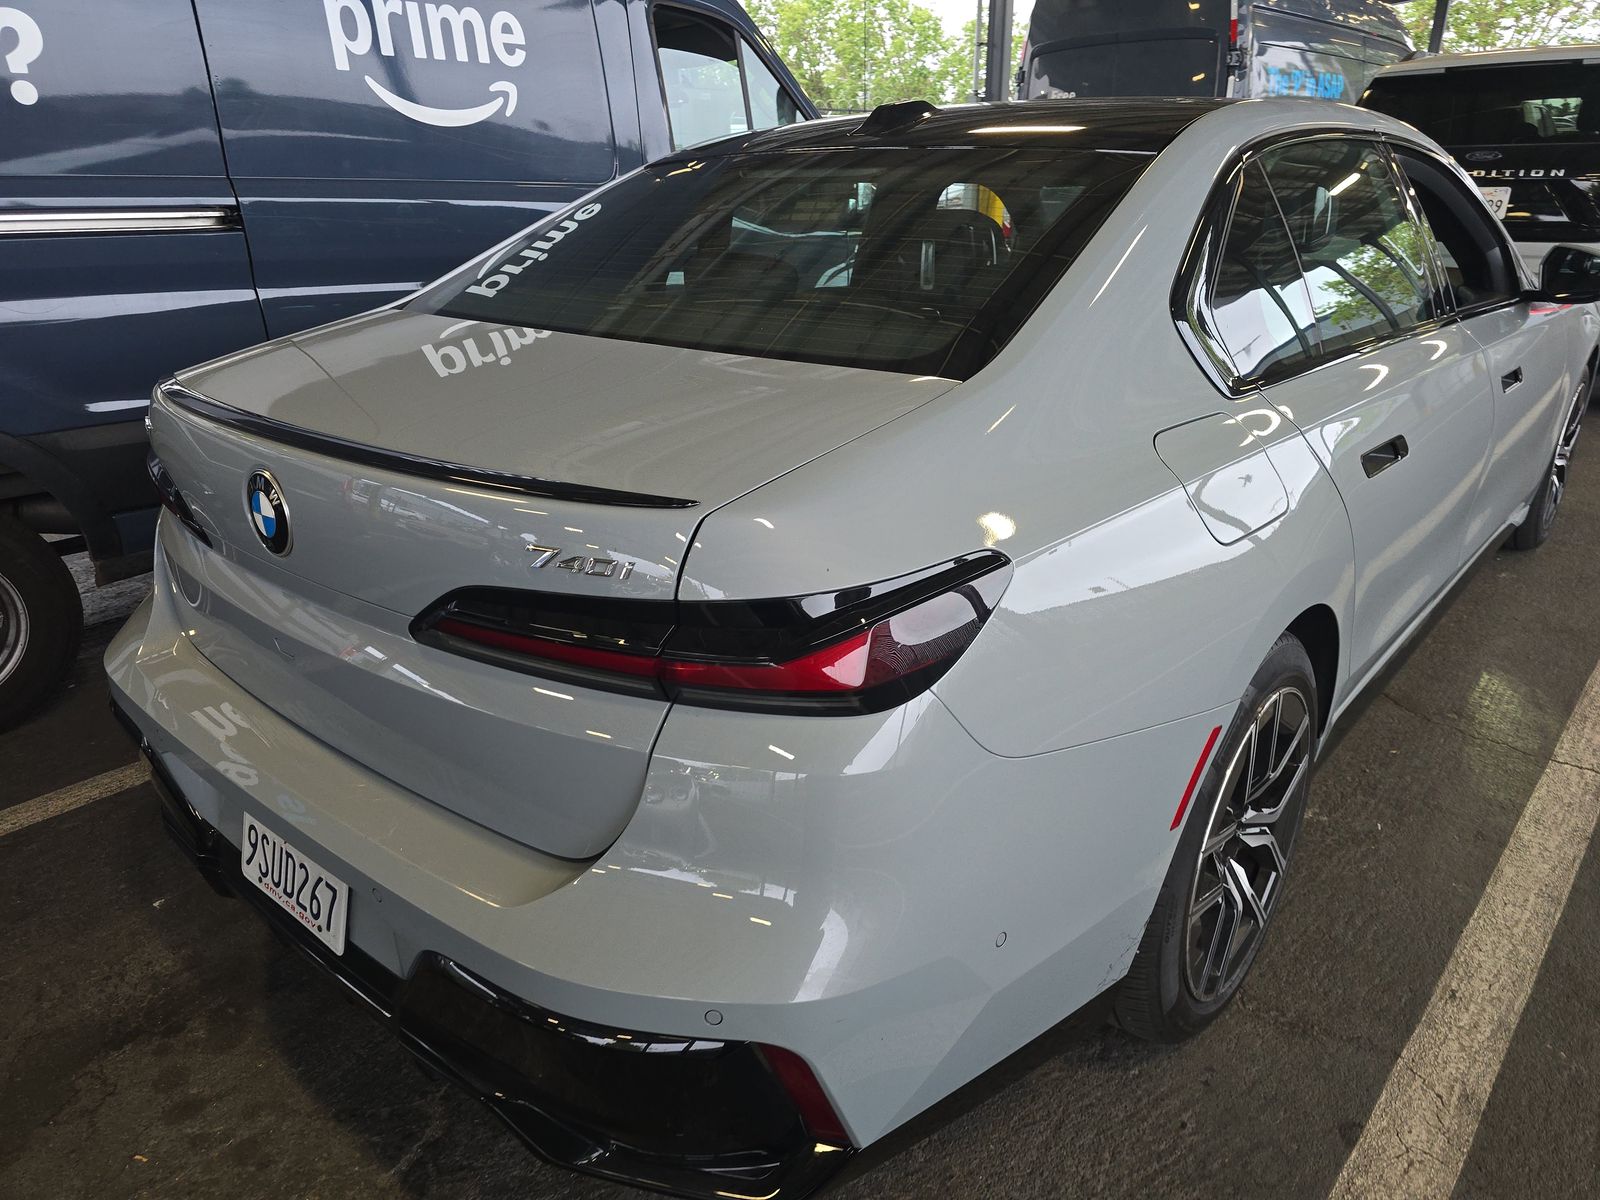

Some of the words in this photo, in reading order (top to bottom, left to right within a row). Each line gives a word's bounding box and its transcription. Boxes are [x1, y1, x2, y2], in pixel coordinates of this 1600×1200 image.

[323, 0, 527, 68] prime
[249, 474, 281, 507] BMW
[524, 542, 636, 580] 740i
[246, 824, 338, 932] 9SUD267
[264, 881, 317, 929] dmv.ca.gov
